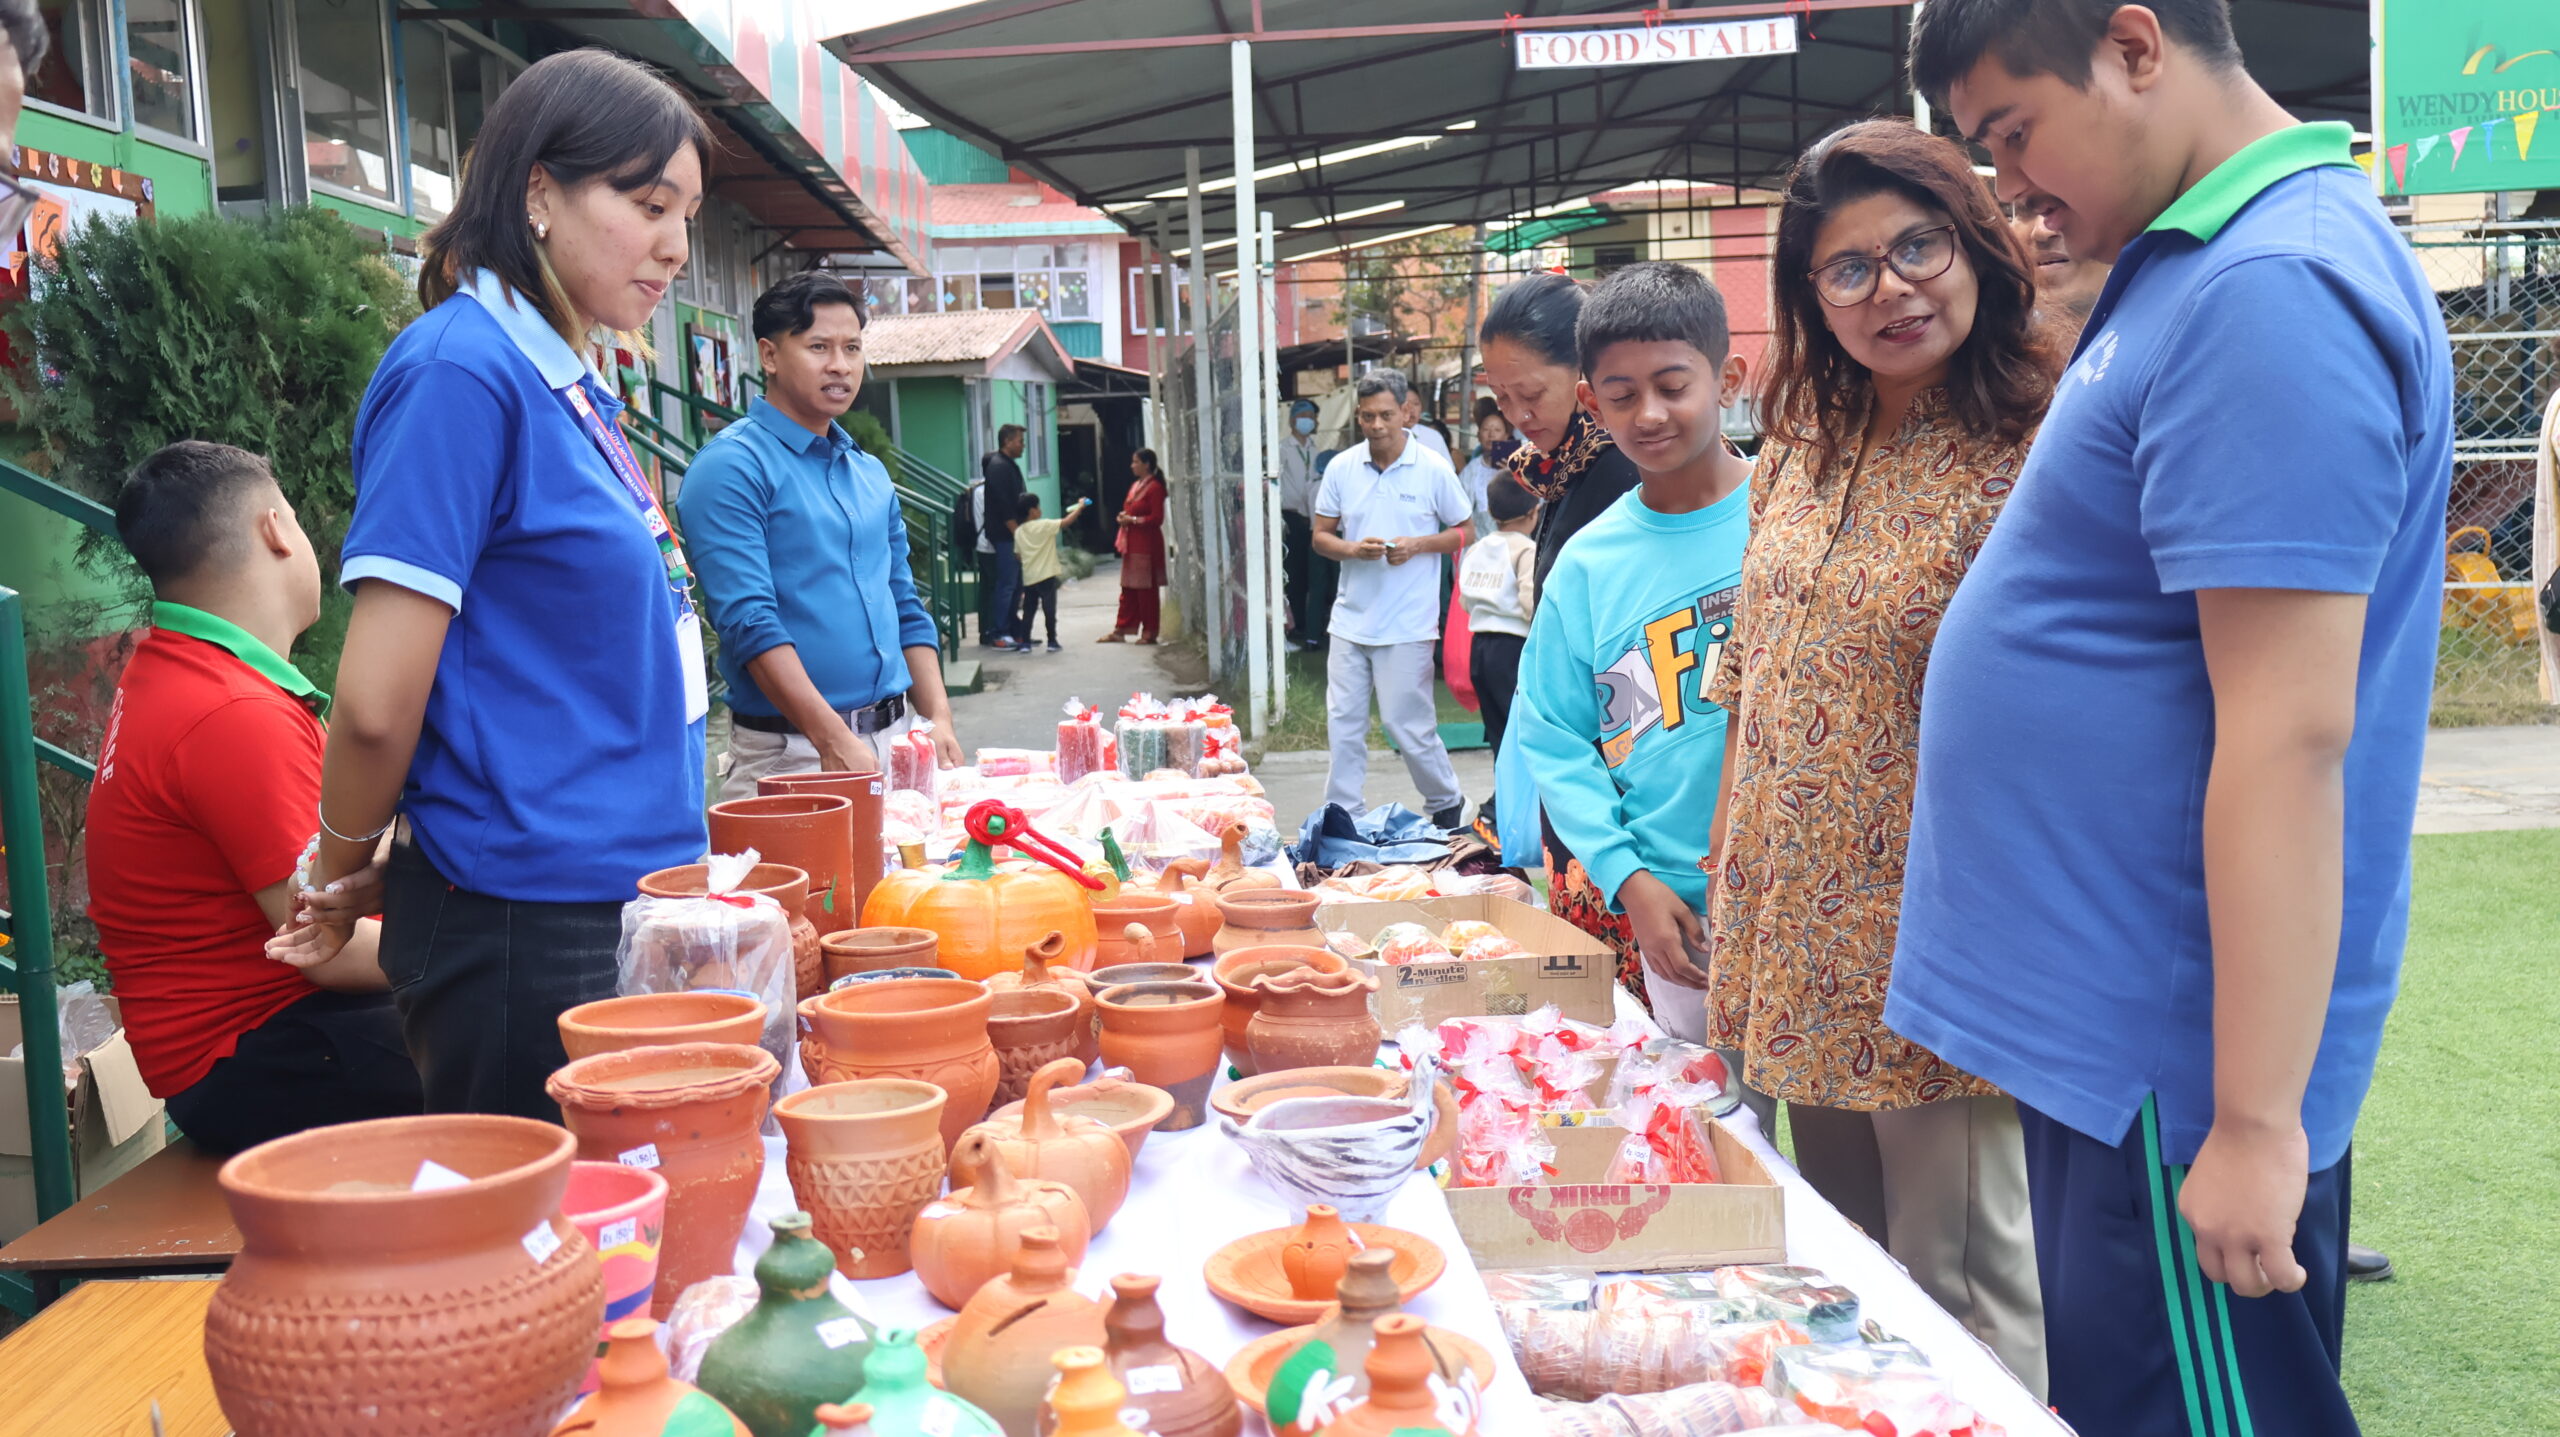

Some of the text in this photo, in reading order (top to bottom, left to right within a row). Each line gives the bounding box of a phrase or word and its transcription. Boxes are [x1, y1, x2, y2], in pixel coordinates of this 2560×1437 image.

[1522, 22, 1793, 65] FOOD STALL
[2397, 88, 2560, 117] WENDYHOU
[594, 426, 646, 502] CENTRE FOR AUTISM
